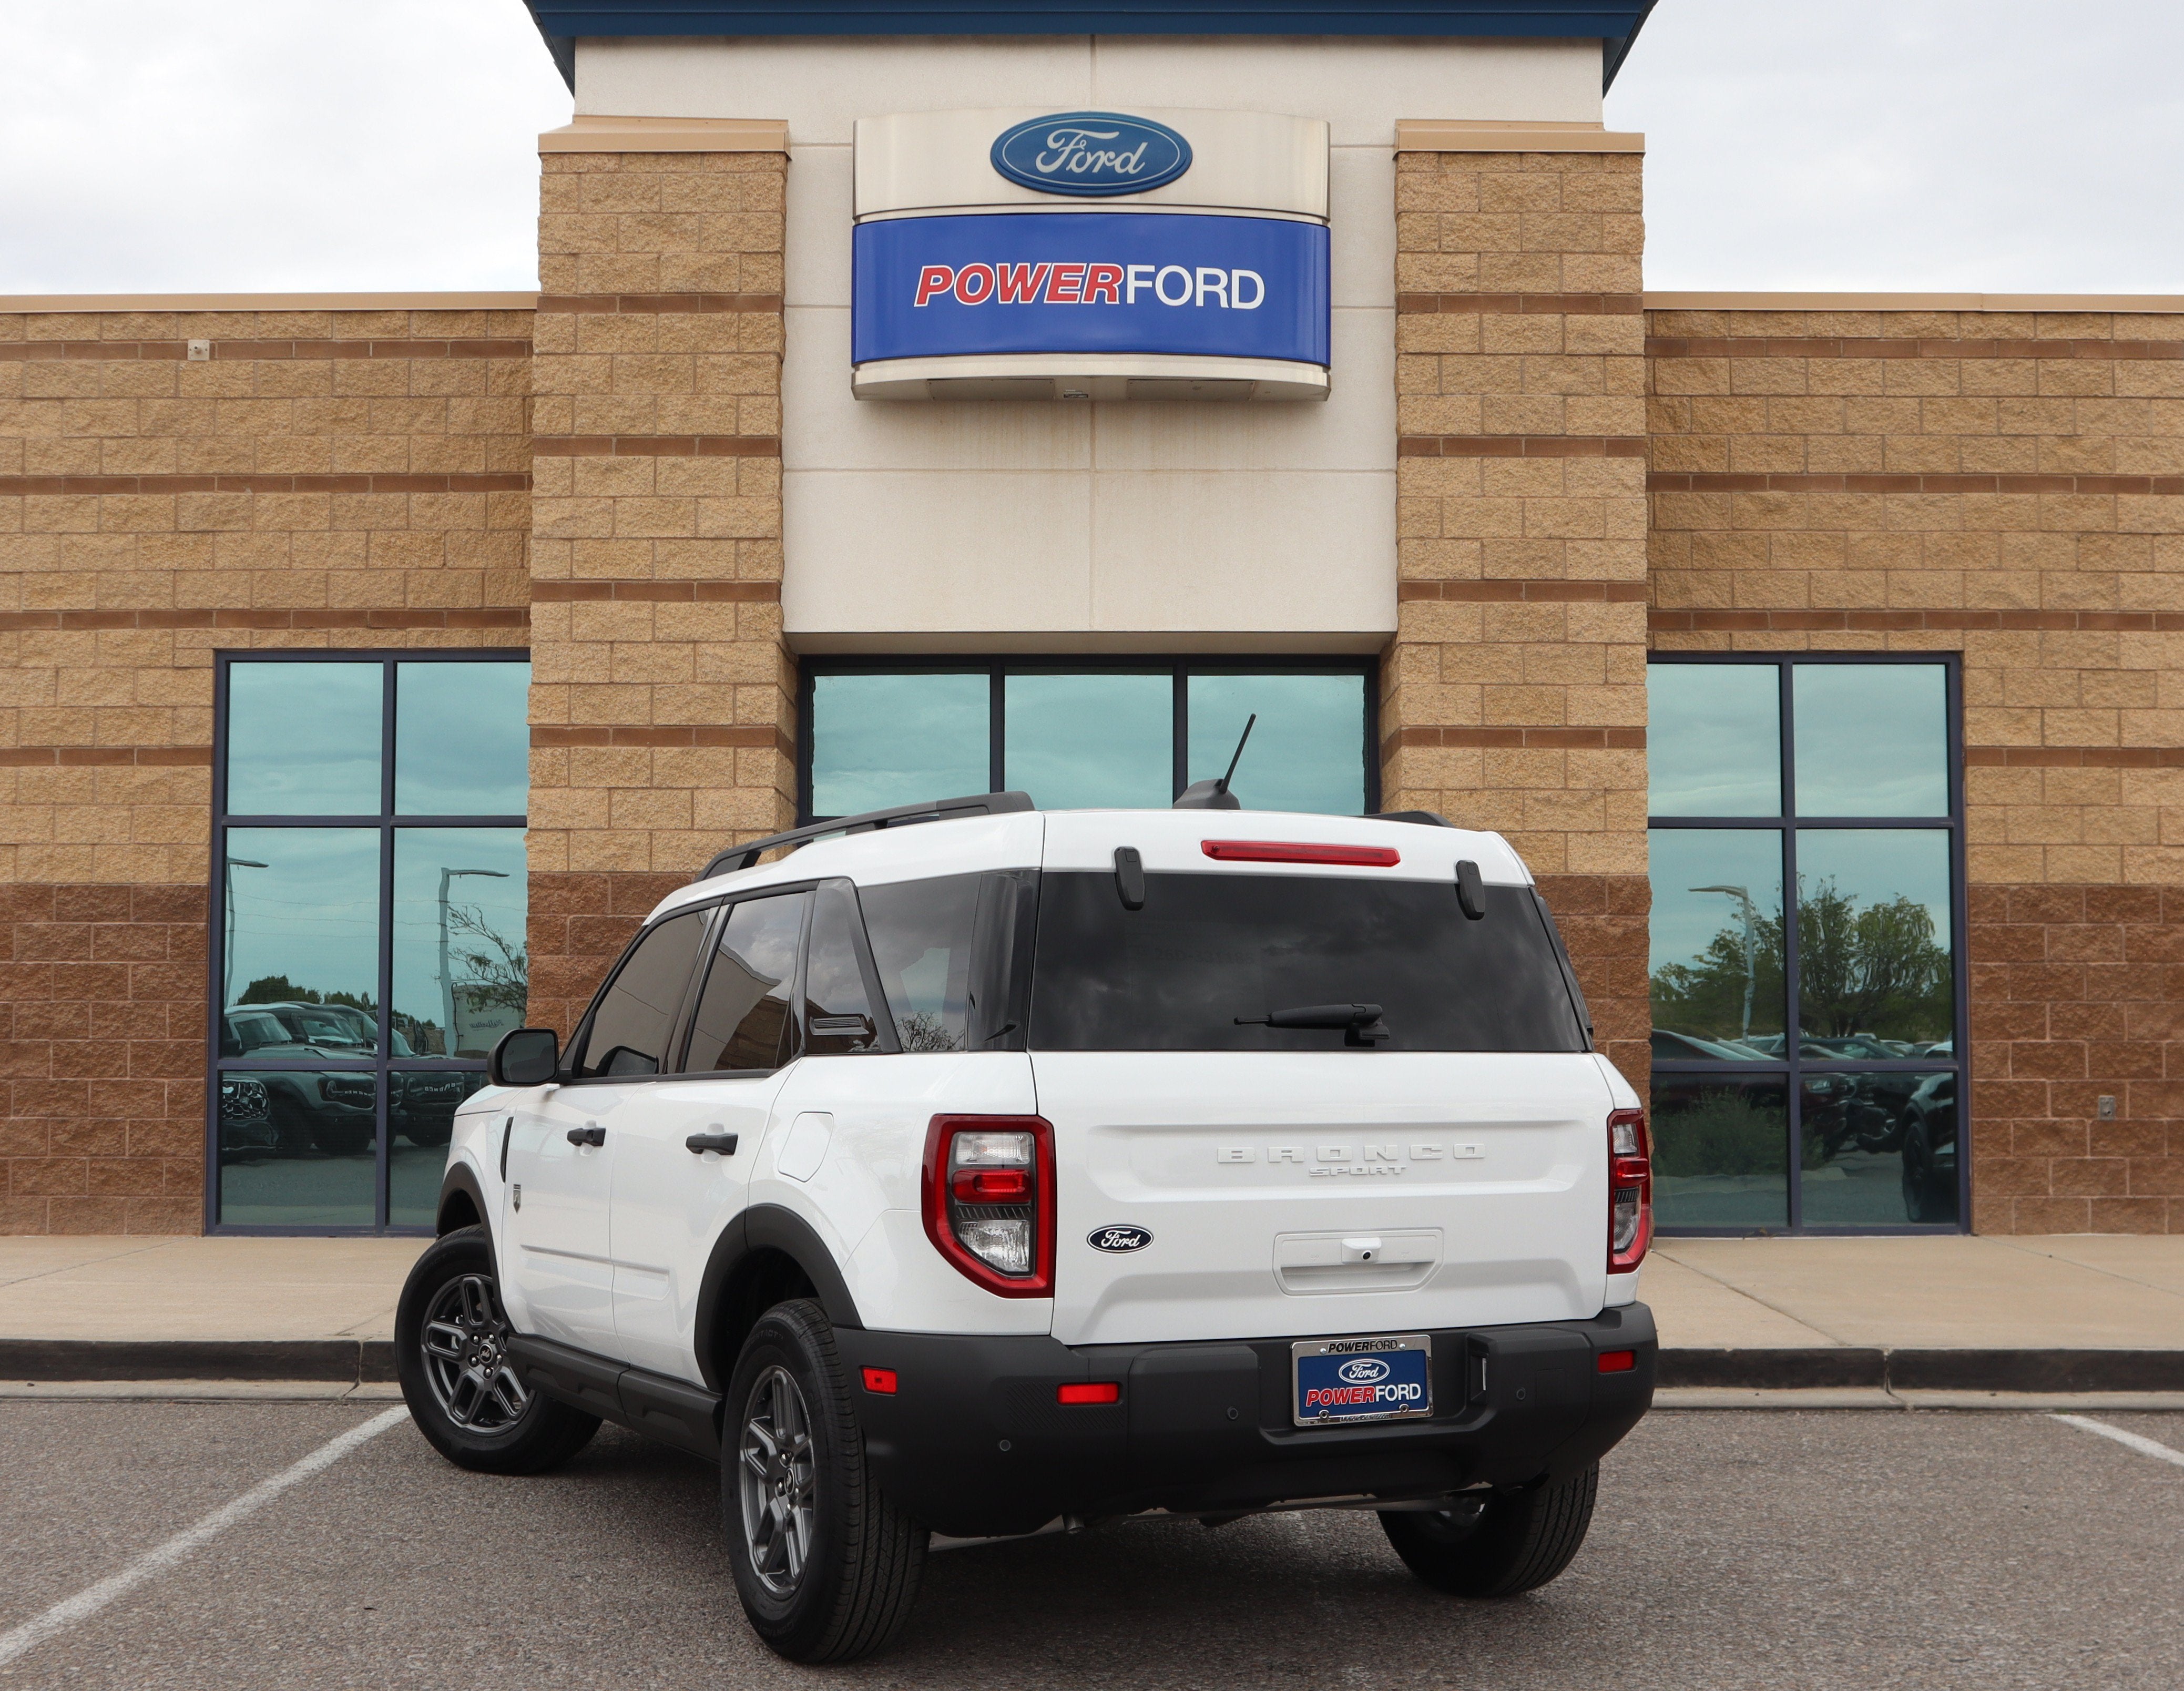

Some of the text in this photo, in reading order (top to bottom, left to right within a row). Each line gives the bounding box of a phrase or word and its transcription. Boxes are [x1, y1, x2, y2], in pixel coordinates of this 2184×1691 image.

[1036, 128, 1148, 175] Ford
[914, 262, 1264, 309] POWERFORD
[1217, 1143, 1485, 1163] BRONCO
[1309, 1165, 1406, 1177] SPORT
[1100, 1230, 1142, 1249] Ford
[1328, 1340, 1397, 1353] POWERFORD
[1349, 1363, 1379, 1379] Ford
[1306, 1383, 1421, 1407] POWERFORD
